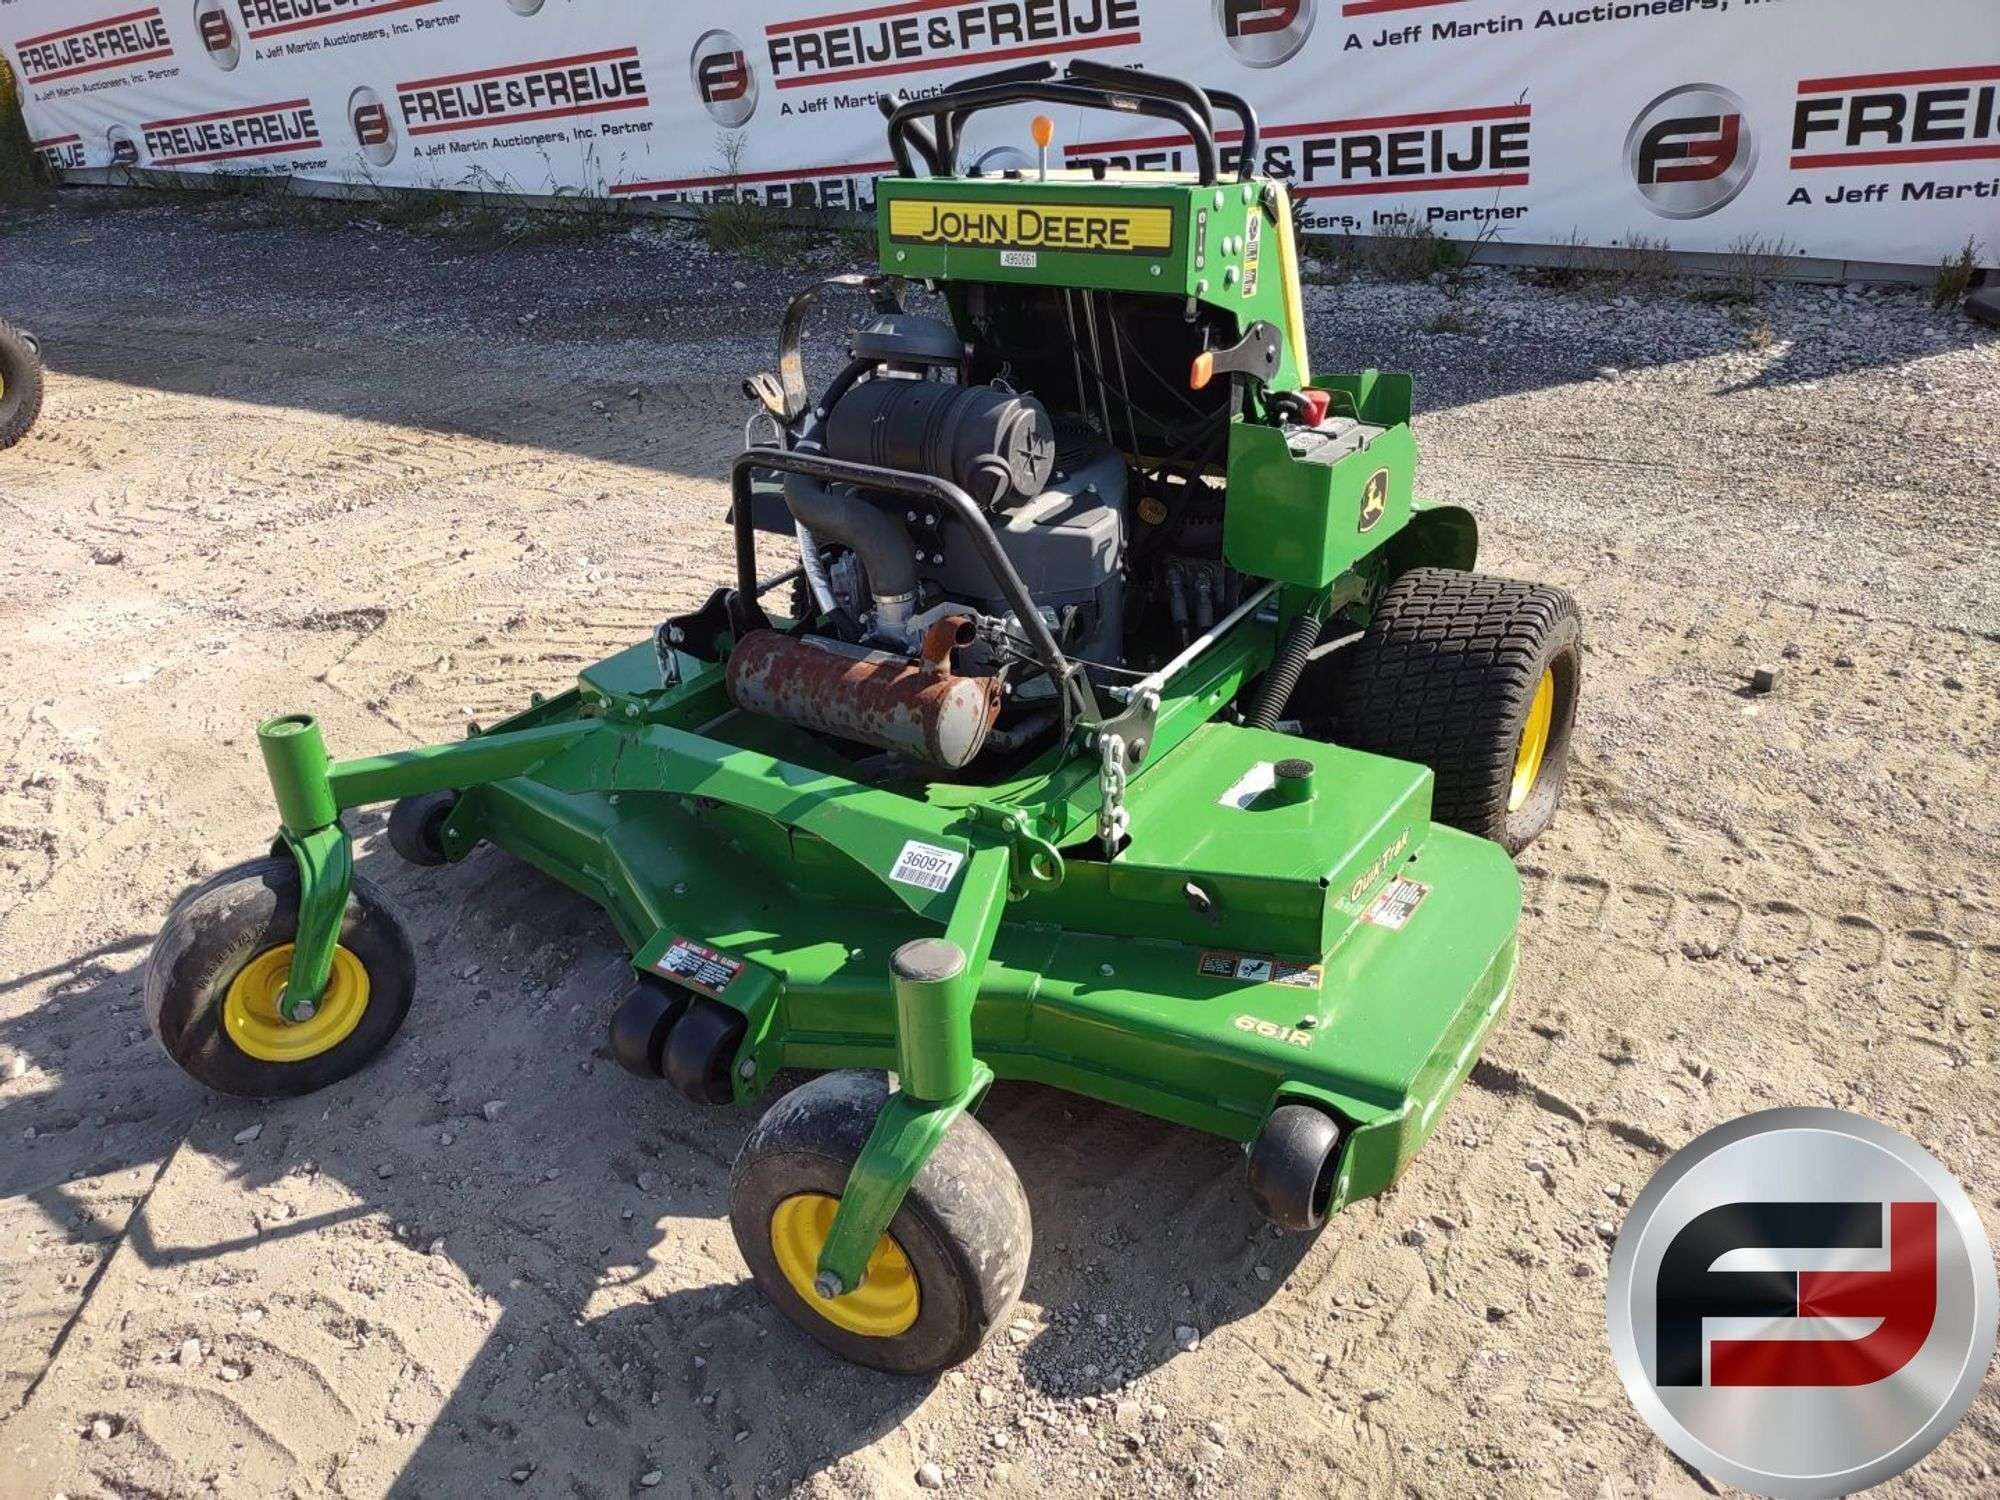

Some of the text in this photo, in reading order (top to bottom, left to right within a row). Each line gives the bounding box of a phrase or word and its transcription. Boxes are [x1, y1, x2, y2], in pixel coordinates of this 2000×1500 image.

[255, 14, 461, 61] A Jeff Martin Auctioneers, Inc. Partner
[1343, 34, 1363, 51] A
[1372, 25, 1422, 47] Jeff
[1432, 15, 1523, 41] Martin
[148, 67, 180, 81] Partner
[780, 102, 793, 116] A
[798, 97, 828, 114] Jeff
[1791, 86, 2000, 150] FREI
[413, 121, 654, 158] A Jeff Martin Auctioneers, Inc. Partner
[1787, 178, 2000, 206] A Jeff Marti
[922, 206, 1131, 246] JOHN DEERE
[1372, 210, 1415, 225] Inc.
[1427, 206, 1528, 223] Partner
[902, 851, 953, 876] 360971
[1234, 1014, 1313, 1048] 661R
